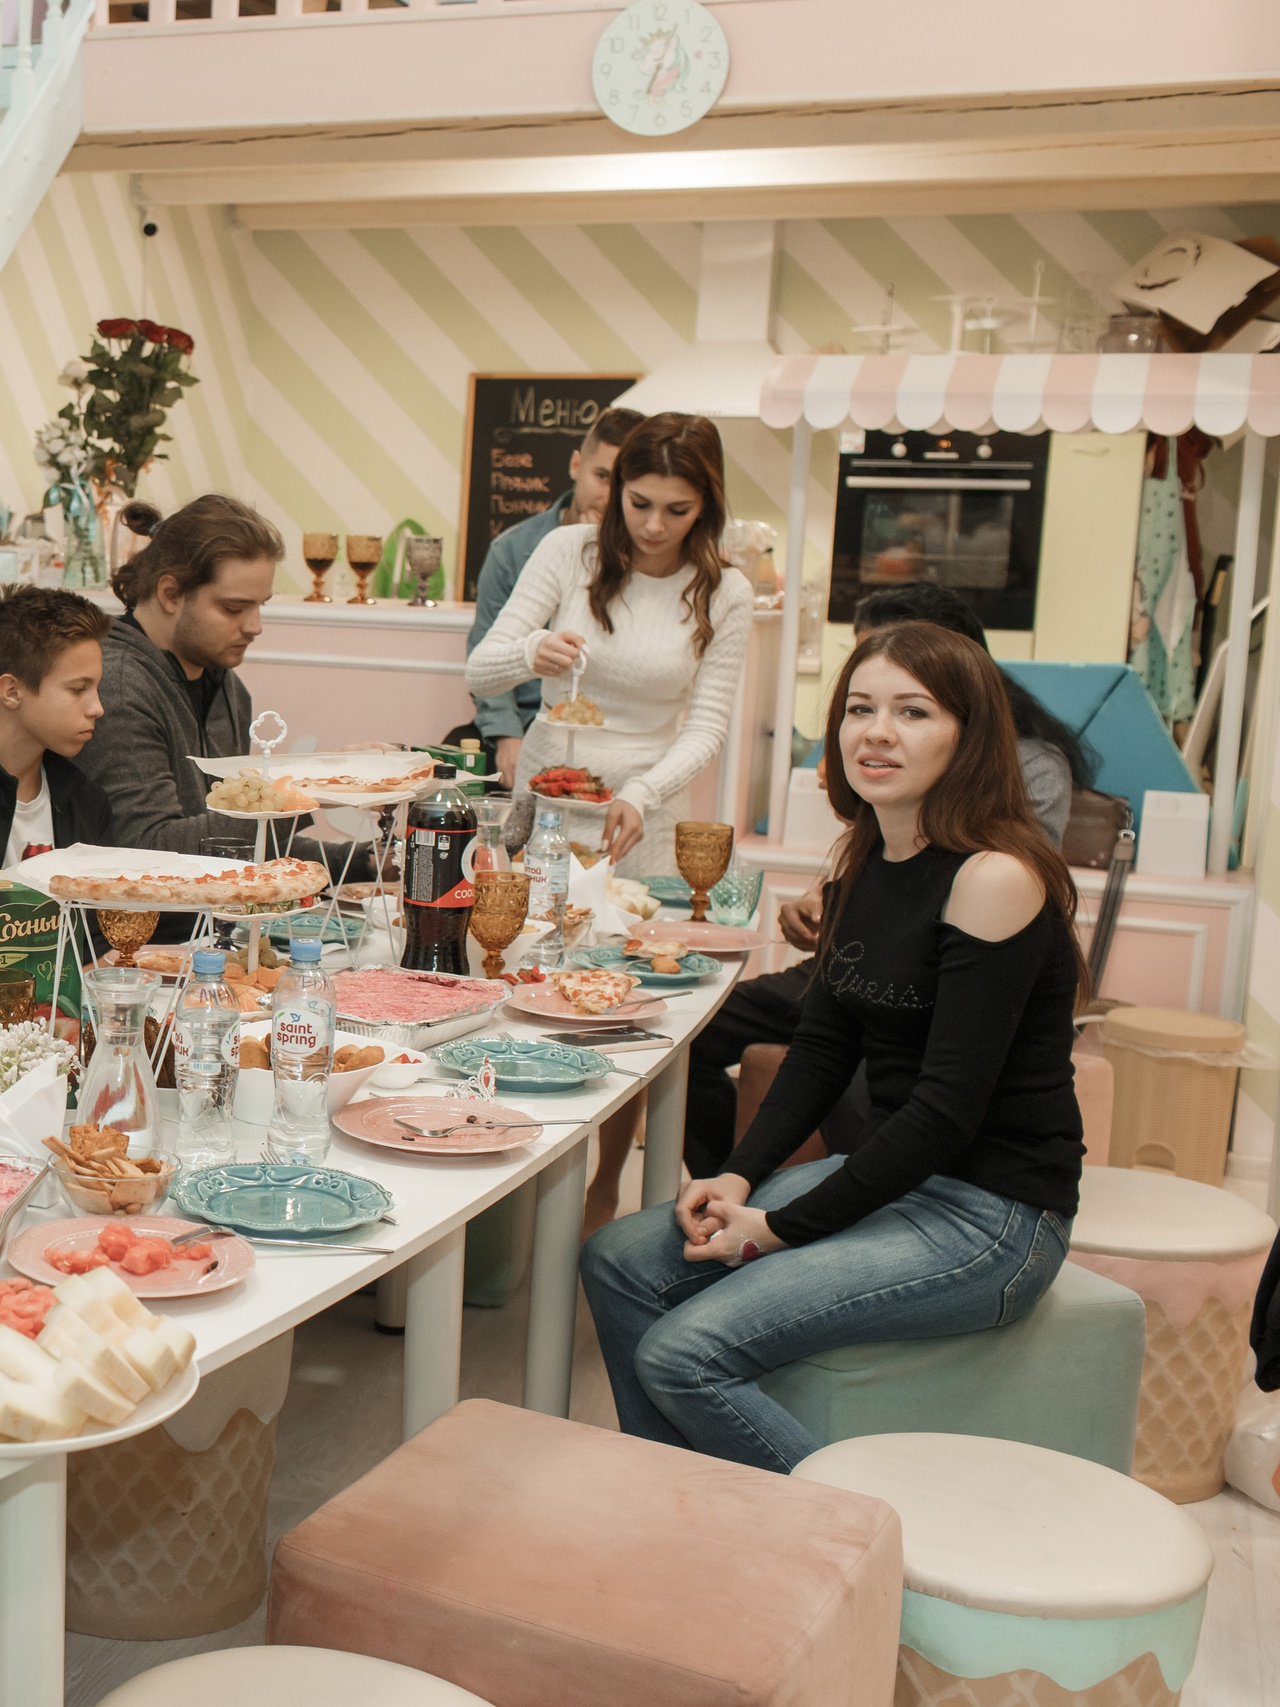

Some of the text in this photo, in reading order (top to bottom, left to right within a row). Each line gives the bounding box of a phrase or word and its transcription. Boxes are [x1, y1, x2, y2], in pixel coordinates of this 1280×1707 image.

[509, 384, 600, 427] Меню
[280, 1022, 312, 1035] saint
[276, 1031, 317, 1049] spring
